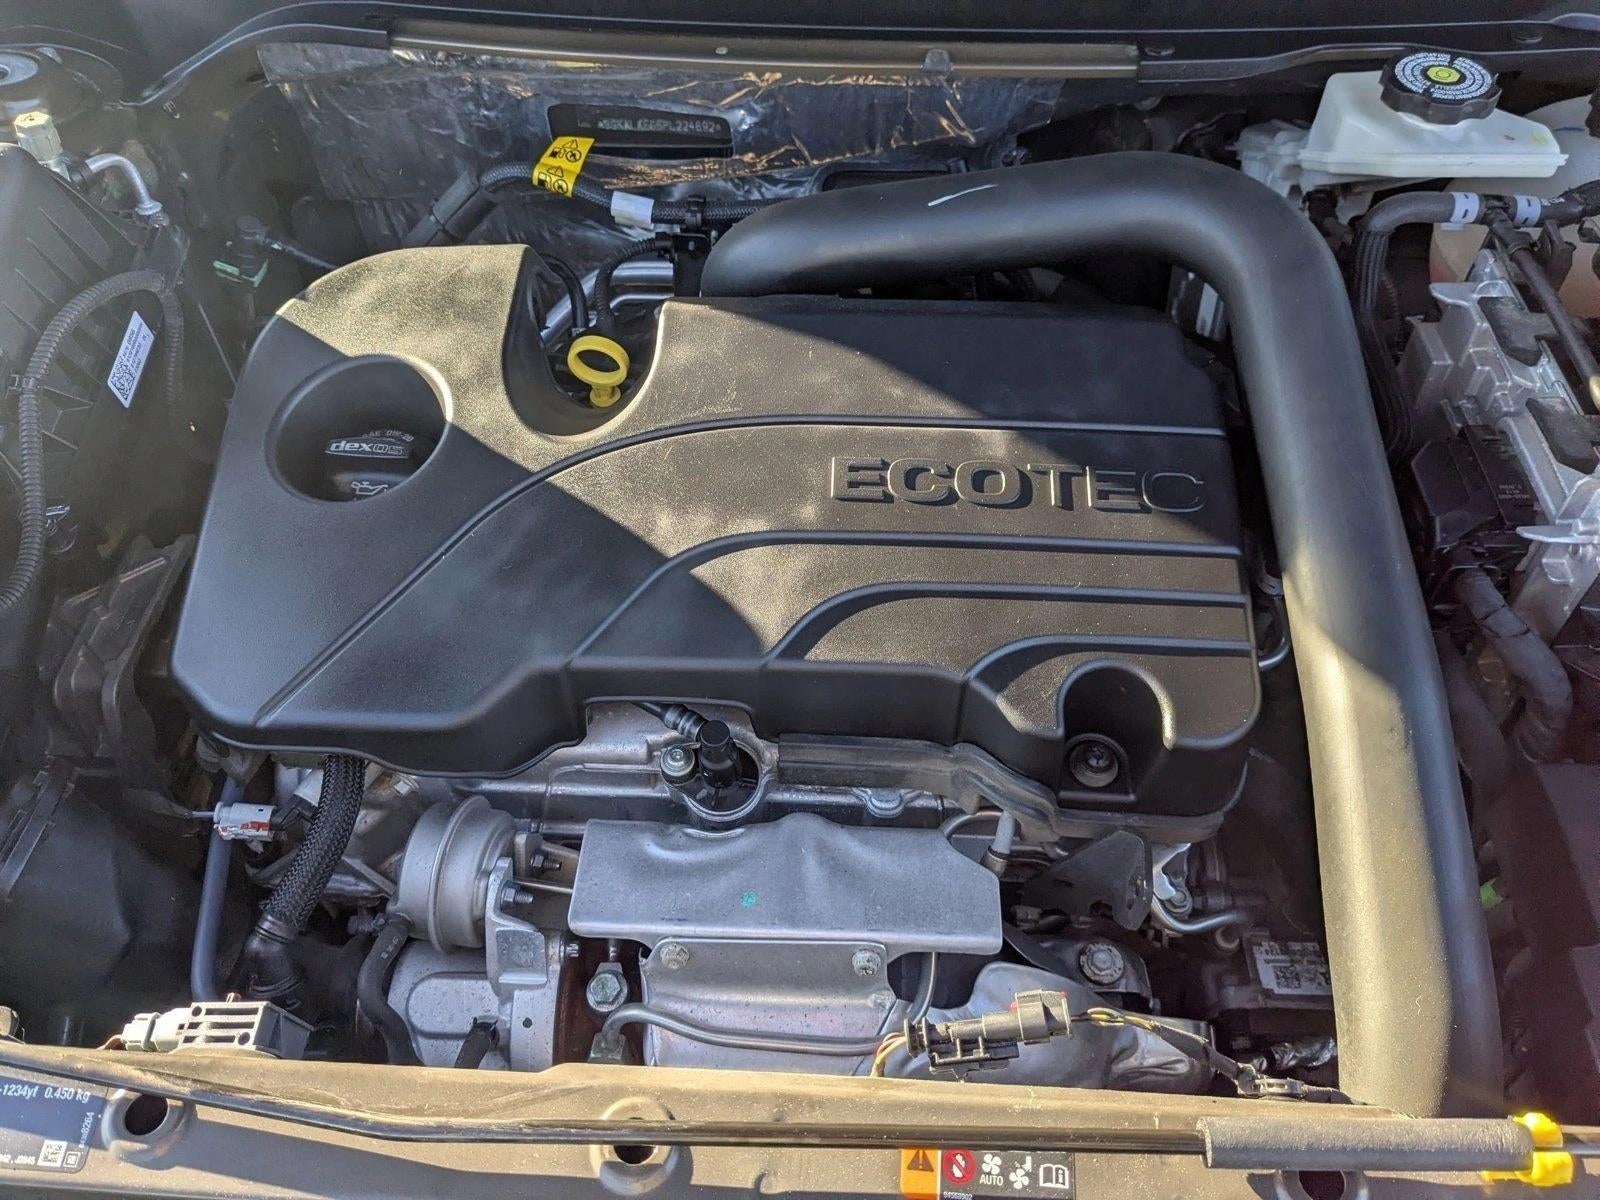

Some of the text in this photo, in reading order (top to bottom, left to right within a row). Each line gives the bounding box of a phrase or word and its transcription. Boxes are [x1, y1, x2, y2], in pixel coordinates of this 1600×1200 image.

[330, 440, 404, 455] dexos
[830, 456, 1206, 515] ECOTEC
[44, 1087, 73, 1100] 0.450
[75, 1089, 91, 1103] kg
[979, 1175, 1004, 1186] AUTO
